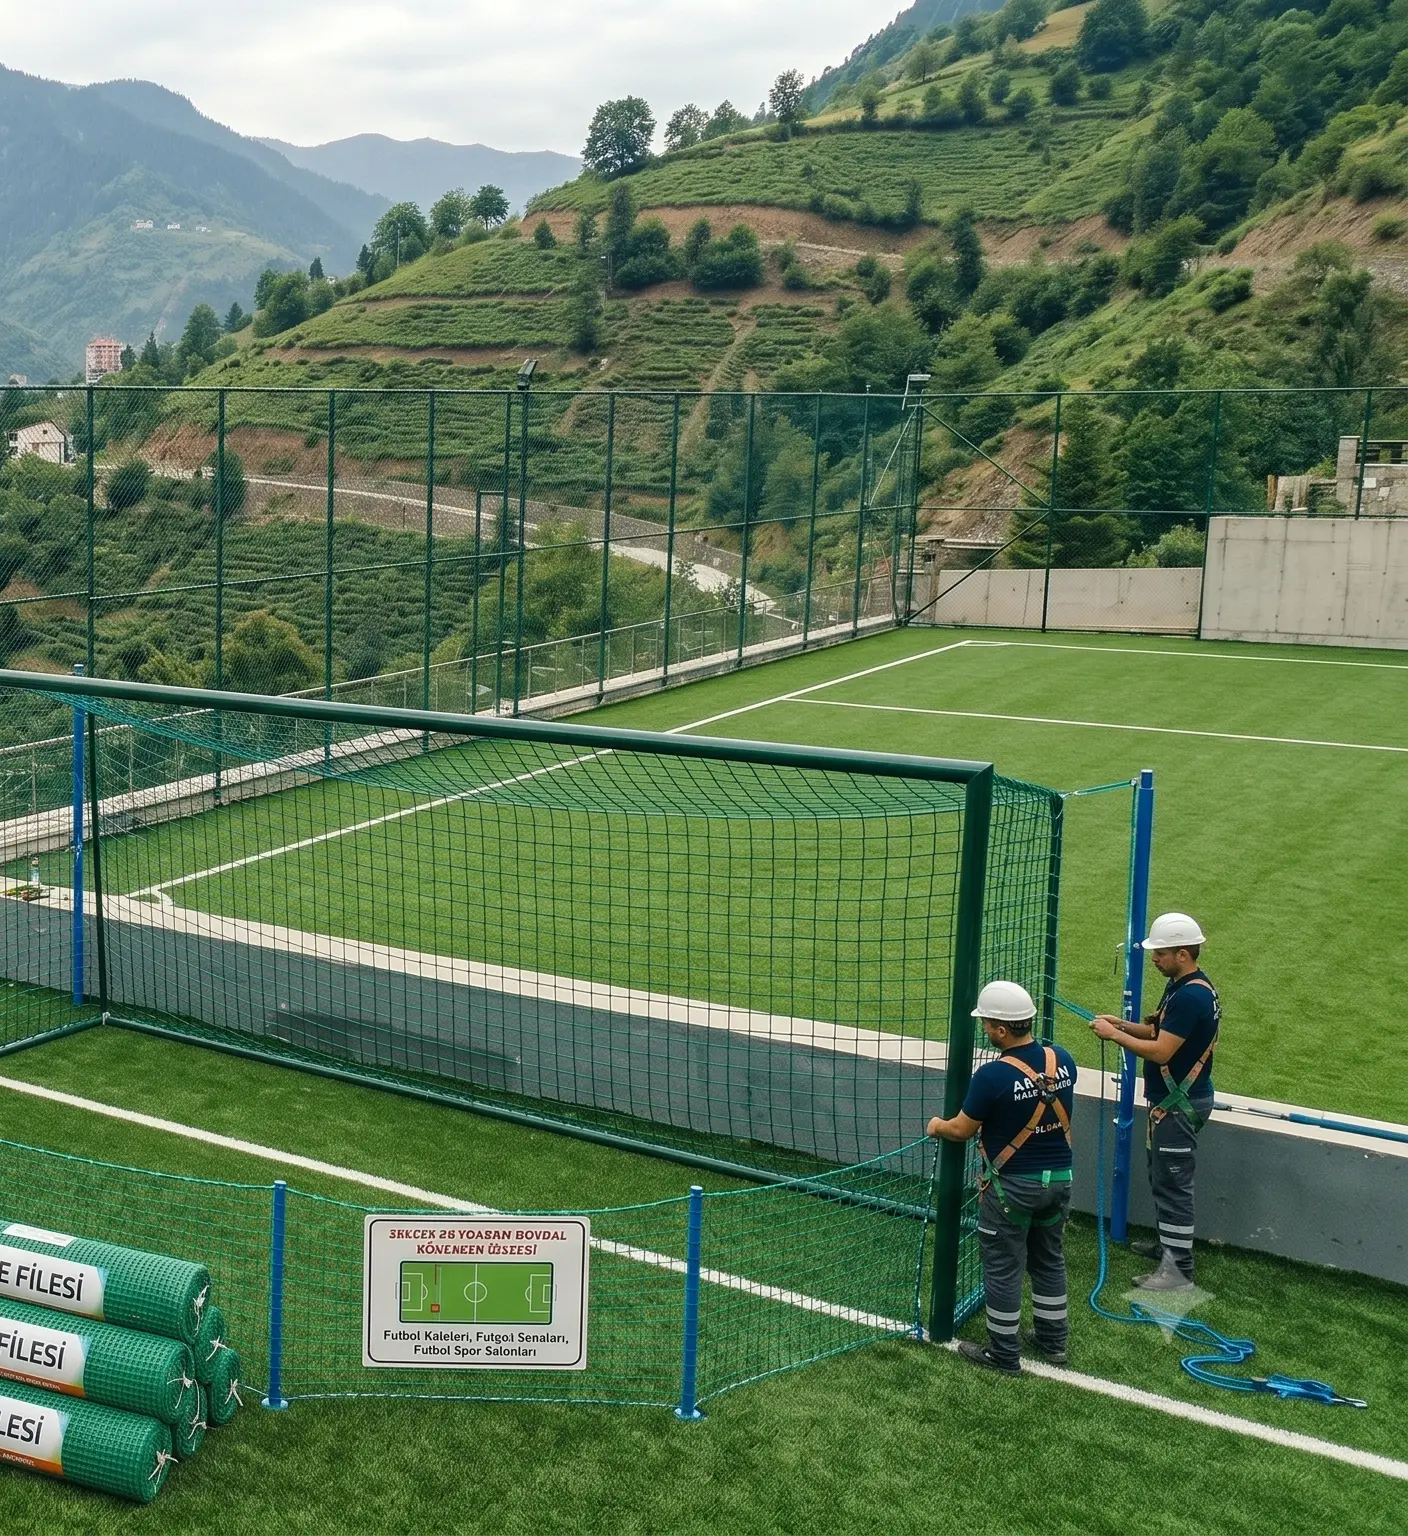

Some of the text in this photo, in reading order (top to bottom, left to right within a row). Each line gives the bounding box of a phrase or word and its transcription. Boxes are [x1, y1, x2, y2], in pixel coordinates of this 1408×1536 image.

[515, 1231, 567, 1241] BOVDAL
[16, 1263, 84, 1301] FİLESİ
[384, 1330, 420, 1341] Futbol
[424, 1331, 472, 1343] Kaleleri,
[518, 1333, 569, 1345] Senaları,
[414, 1345, 536, 1358] Futbol Spor Salonları
